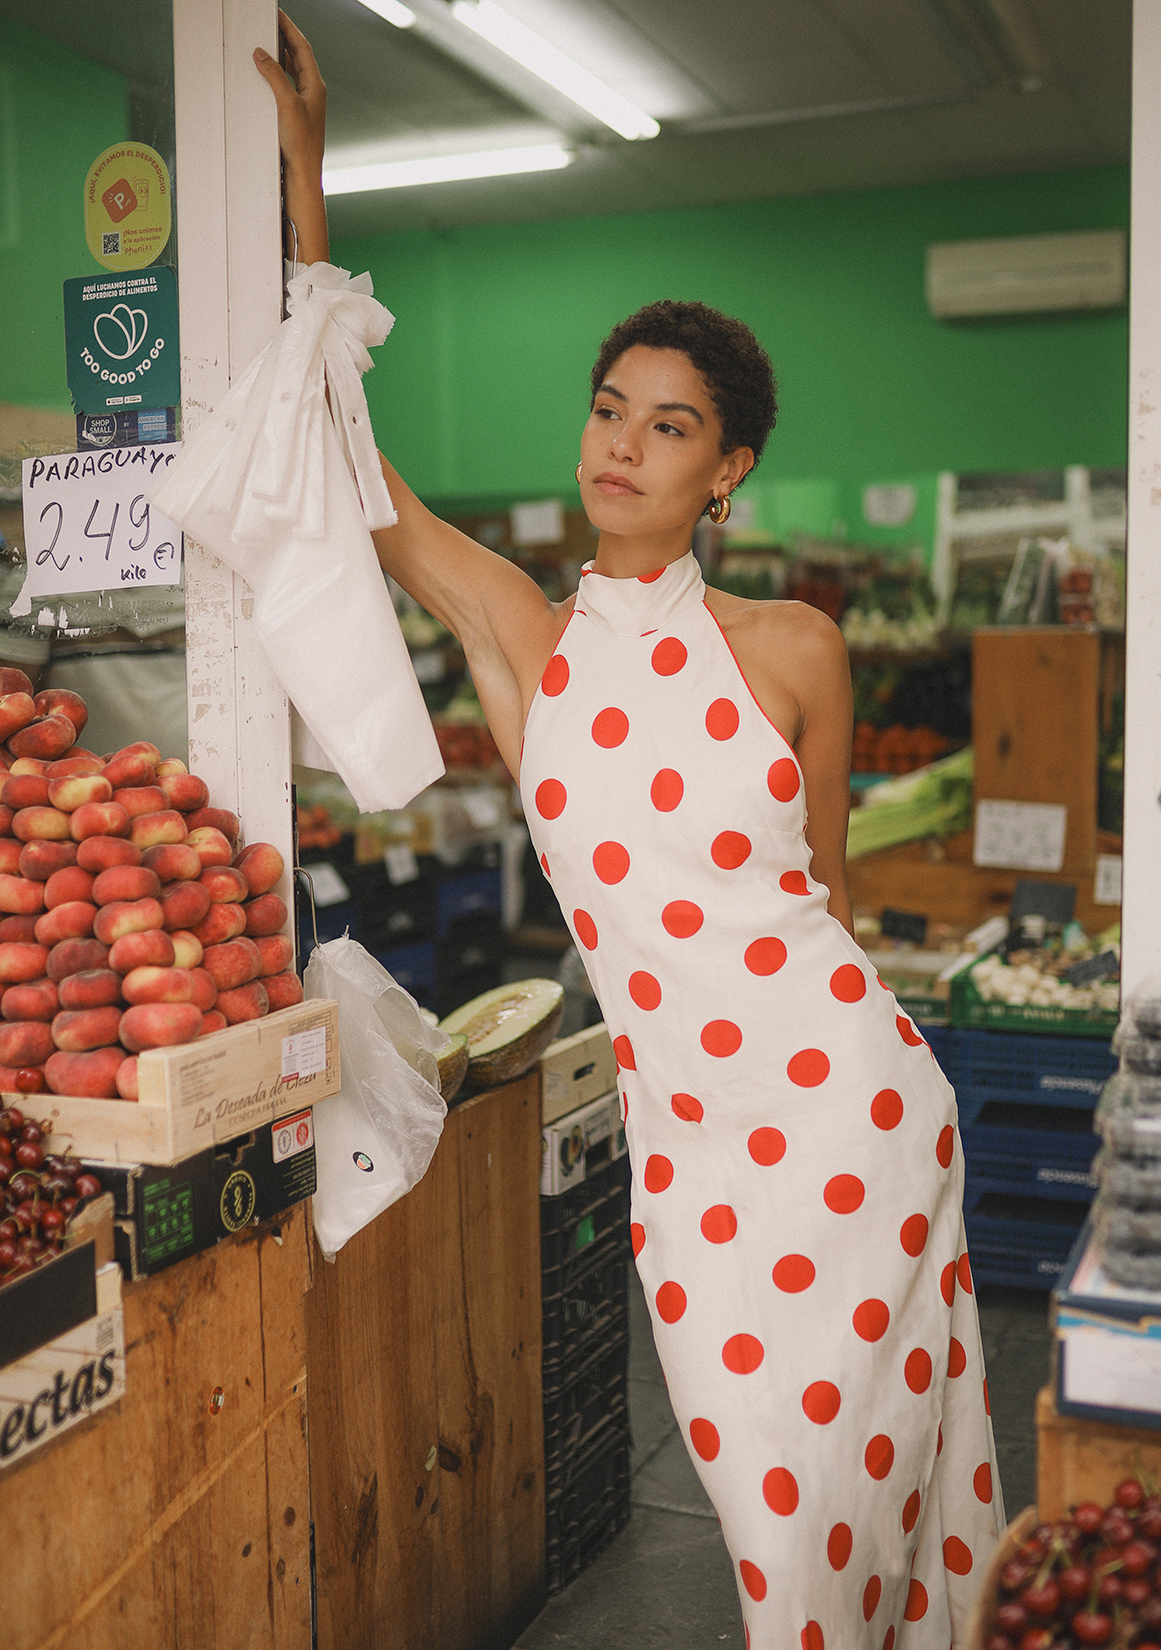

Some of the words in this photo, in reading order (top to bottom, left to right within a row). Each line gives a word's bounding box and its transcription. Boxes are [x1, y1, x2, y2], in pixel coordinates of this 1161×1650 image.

[95, 150, 126, 177] EVITAMOS
[135, 151, 167, 195] DESPERDICIO!
[113, 191, 125, 211] P
[123, 228, 138, 238] ¡Nos
[138, 226, 162, 235] unimos
[133, 235, 161, 244] aplicación
[82, 283, 97, 294] AQUÍ
[97, 281, 126, 292] LUCHAMOS
[127, 278, 149, 289] CONTRA
[149, 277, 157, 285] EL
[82, 289, 118, 301] DESPERDICIO
[119, 288, 126, 297] DE
[126, 284, 158, 296] ALIMENTOS
[80, 347, 100, 374] TOO
[100, 370, 136, 386] GOOD
[135, 358, 152, 376] TO
[149, 337, 166, 359] GO
[91, 418, 110, 428] SHOP
[138, 415, 165, 424] AMERICAN
[89, 425, 112, 435] SMALL
[35, 493, 150, 572] 2.49
[153, 541, 175, 570] €
[193, 1107, 212, 1131] La
[214, 1081, 267, 1121] Deseada
[270, 1072, 284, 1099] de
